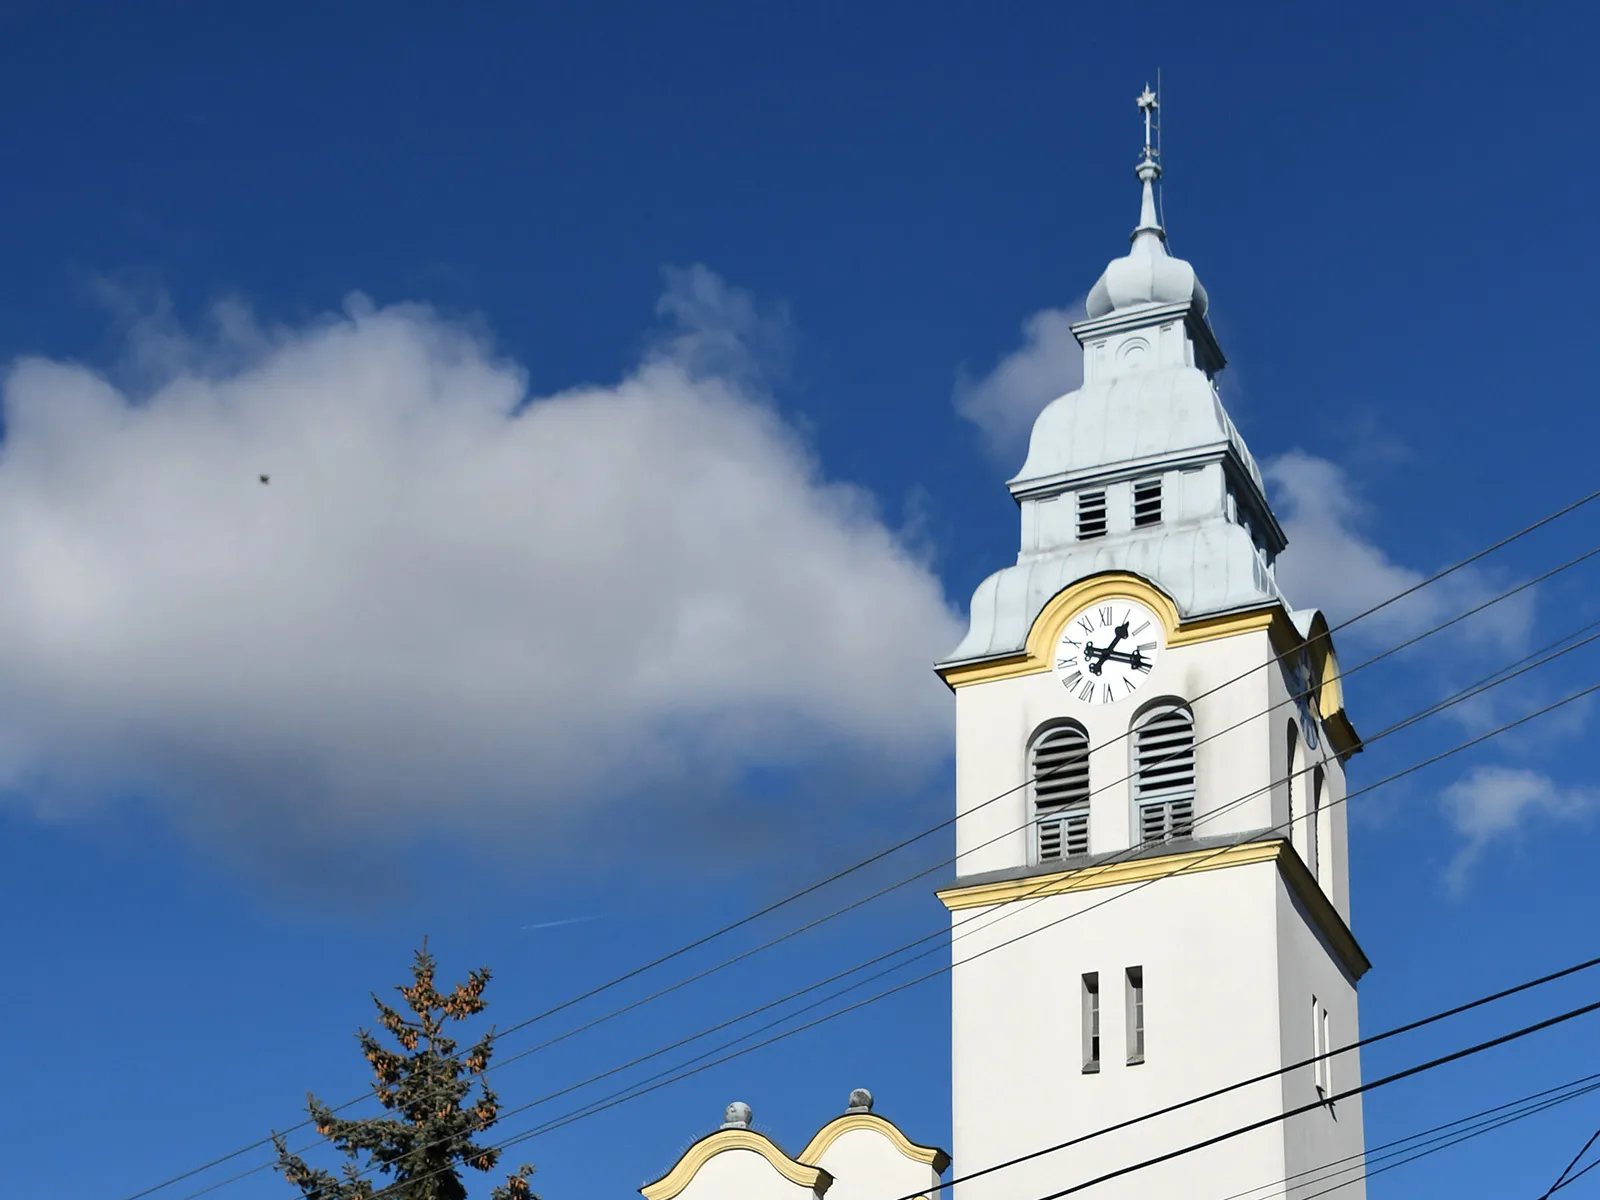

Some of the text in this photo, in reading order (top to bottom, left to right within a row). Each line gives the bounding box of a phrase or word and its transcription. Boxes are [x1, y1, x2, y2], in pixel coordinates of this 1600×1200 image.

[1077, 615, 1095, 636] XI
[1099, 607, 1112, 627] XII
[1062, 636, 1082, 649] X
[1057, 656, 1077, 669] IX
[1103, 683, 1114, 703] VI
[1123, 676, 1136, 693] V
